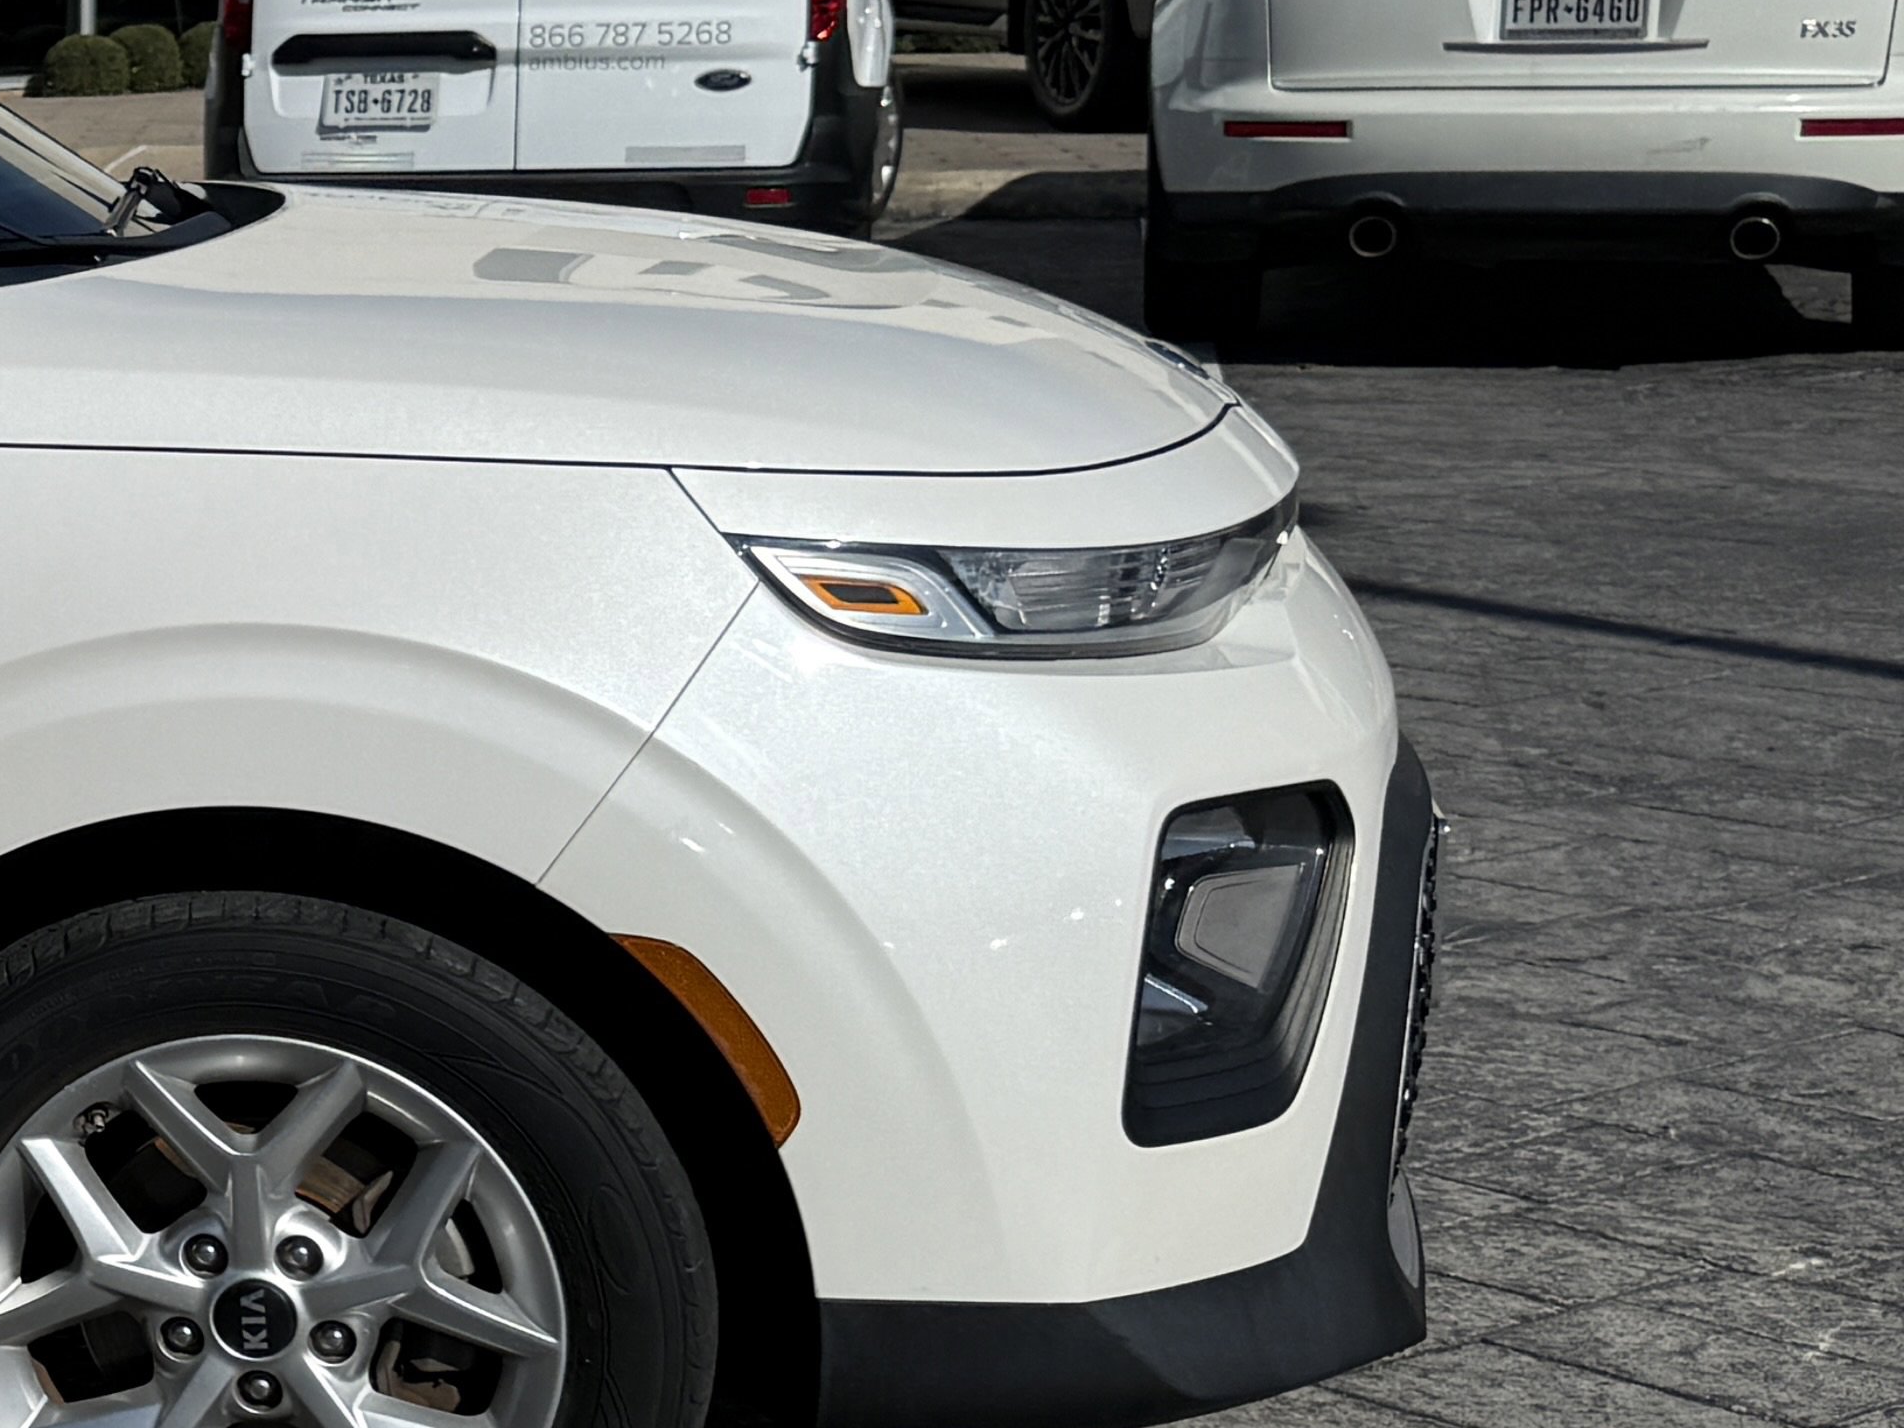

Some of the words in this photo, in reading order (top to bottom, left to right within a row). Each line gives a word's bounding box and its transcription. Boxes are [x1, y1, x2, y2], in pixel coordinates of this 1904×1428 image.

[528, 24, 585, 49] 866
[594, 22, 648, 47] 787
[657, 21, 733, 46] 5268
[528, 52, 667, 71] ambius.com
[239, 1288, 269, 1351] KIA
